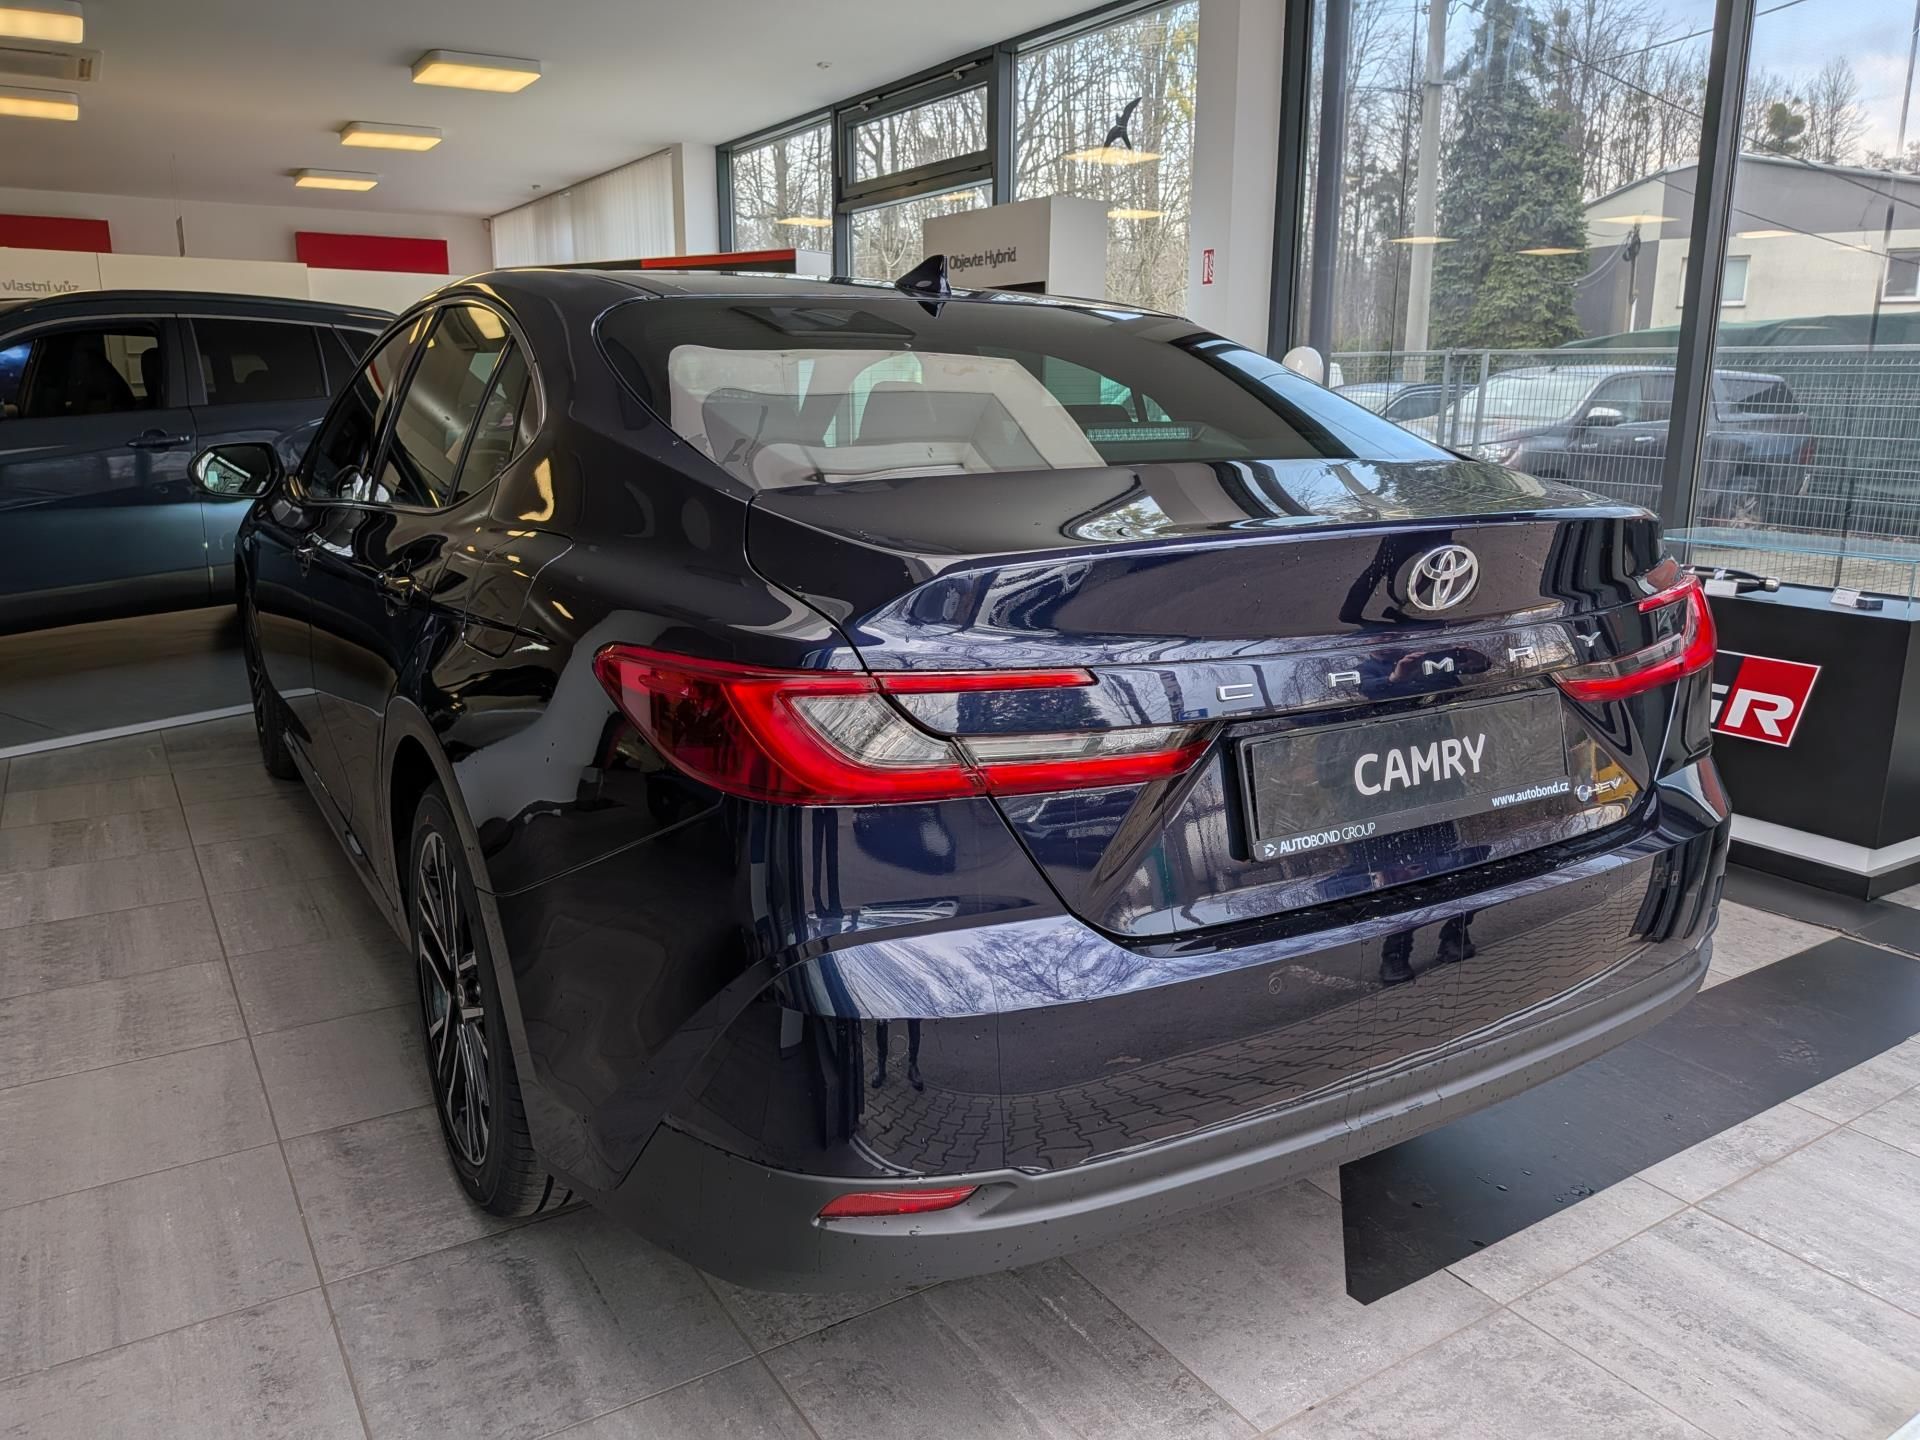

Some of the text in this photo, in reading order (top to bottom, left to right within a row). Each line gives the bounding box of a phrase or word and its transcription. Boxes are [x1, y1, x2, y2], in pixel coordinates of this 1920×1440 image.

[948, 246, 1017, 272] Objevte Hybrid
[2, 279, 80, 292] vlastní vůz
[1215, 630, 1601, 701] CAMRY
[1353, 733, 1486, 796] CAMRY
[1491, 780, 1570, 807] www.autobond.cz
[1279, 821, 1376, 854] AUTOBOND GROUP
